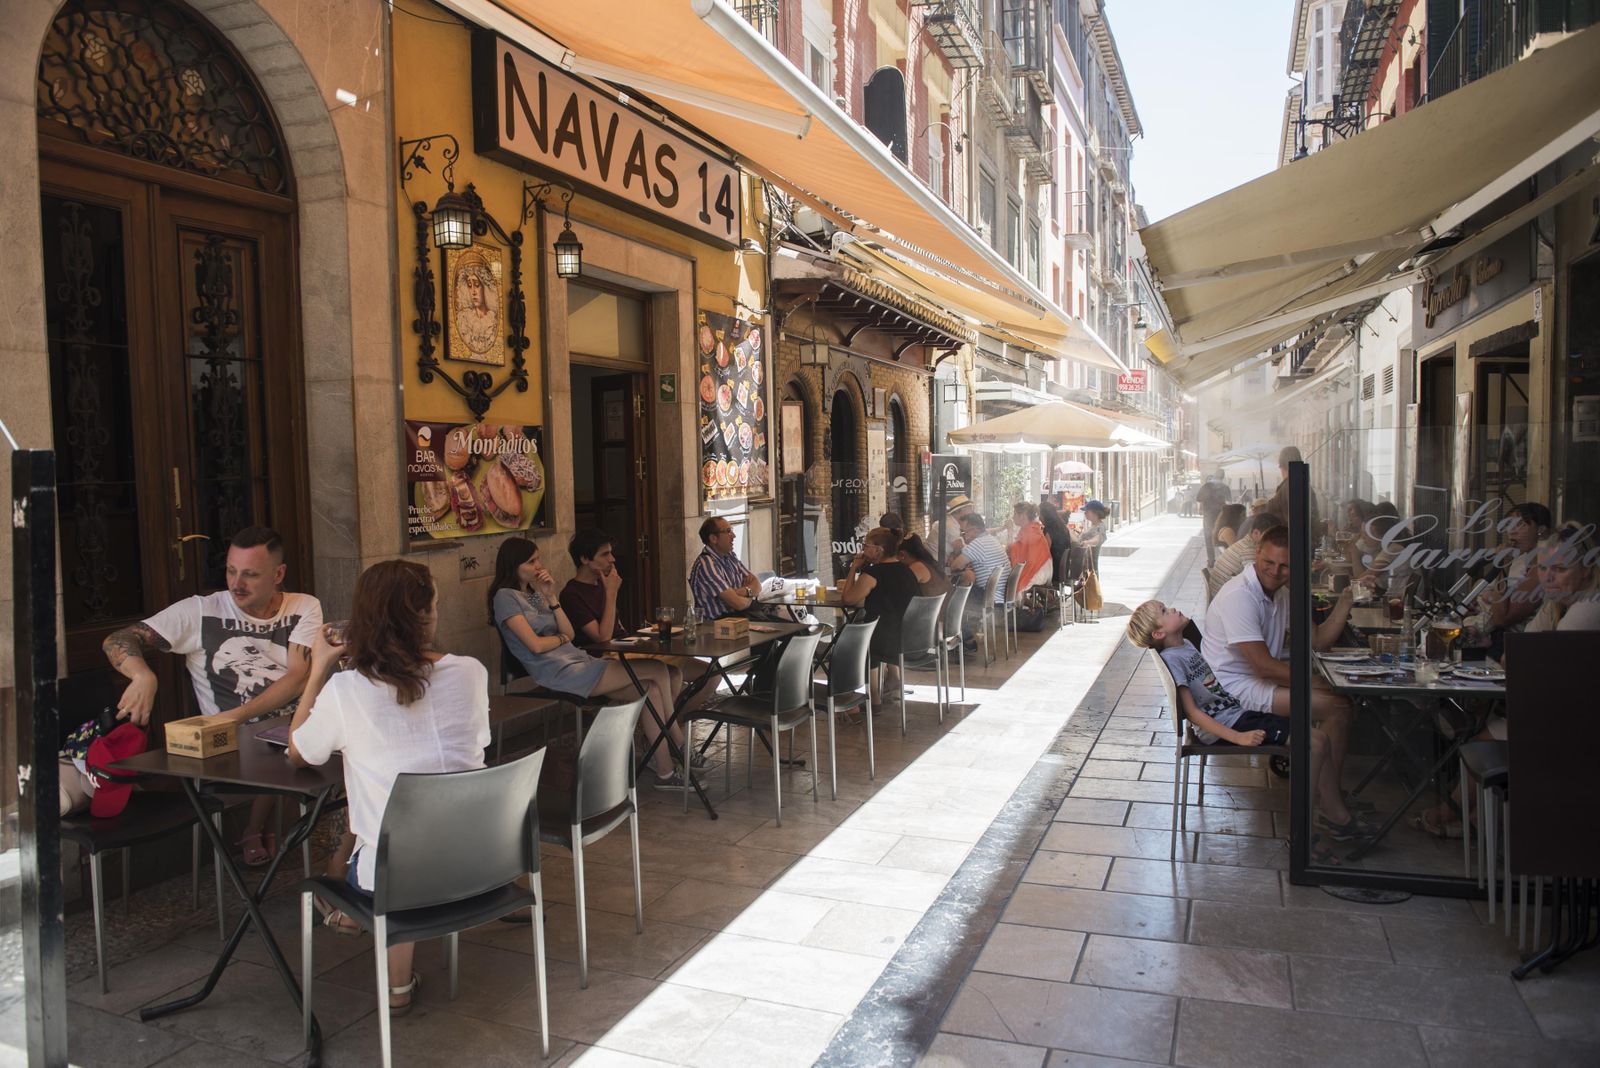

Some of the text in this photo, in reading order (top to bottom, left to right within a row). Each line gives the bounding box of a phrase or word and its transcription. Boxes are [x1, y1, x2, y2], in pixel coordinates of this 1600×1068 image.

[504, 51, 735, 235] NAVAS 14
[450, 427, 538, 456] Montaditos
[415, 450, 436, 463] BAR
[408, 505, 432, 514] Pruebe
[408, 515, 435, 524] nuestras
[1446, 497, 1523, 534] La
